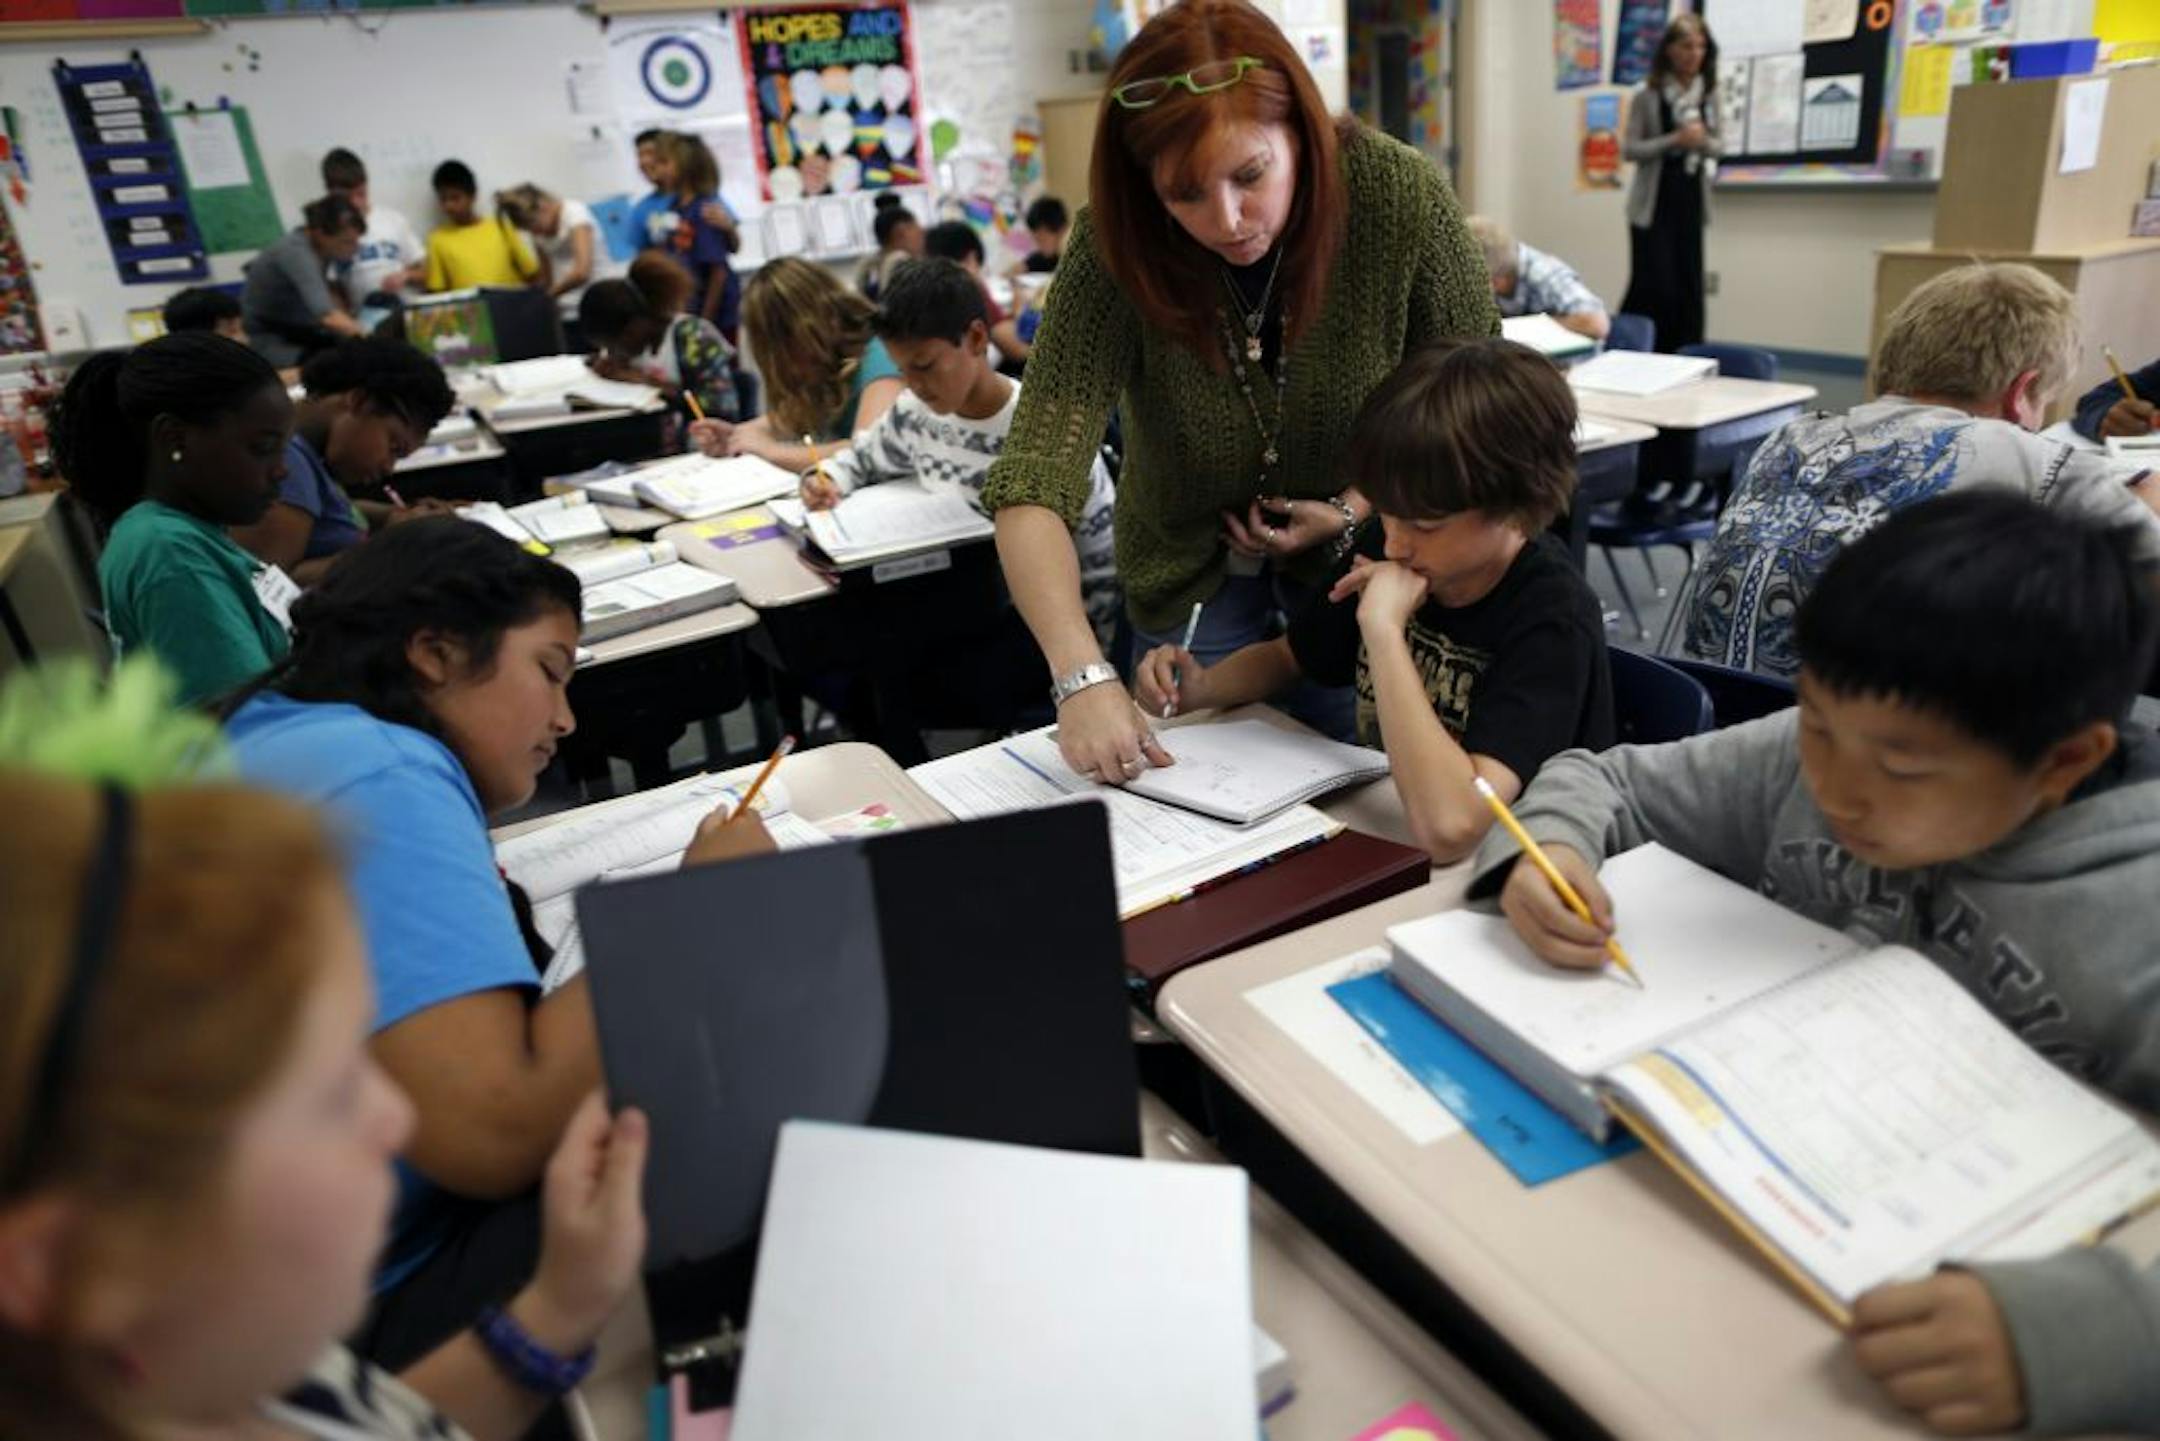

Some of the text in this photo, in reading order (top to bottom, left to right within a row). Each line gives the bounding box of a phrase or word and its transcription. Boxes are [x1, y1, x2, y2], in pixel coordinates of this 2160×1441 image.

[749, 12, 843, 44] HOPES
[848, 9, 901, 37] AND
[785, 35, 898, 68] DREAMS
